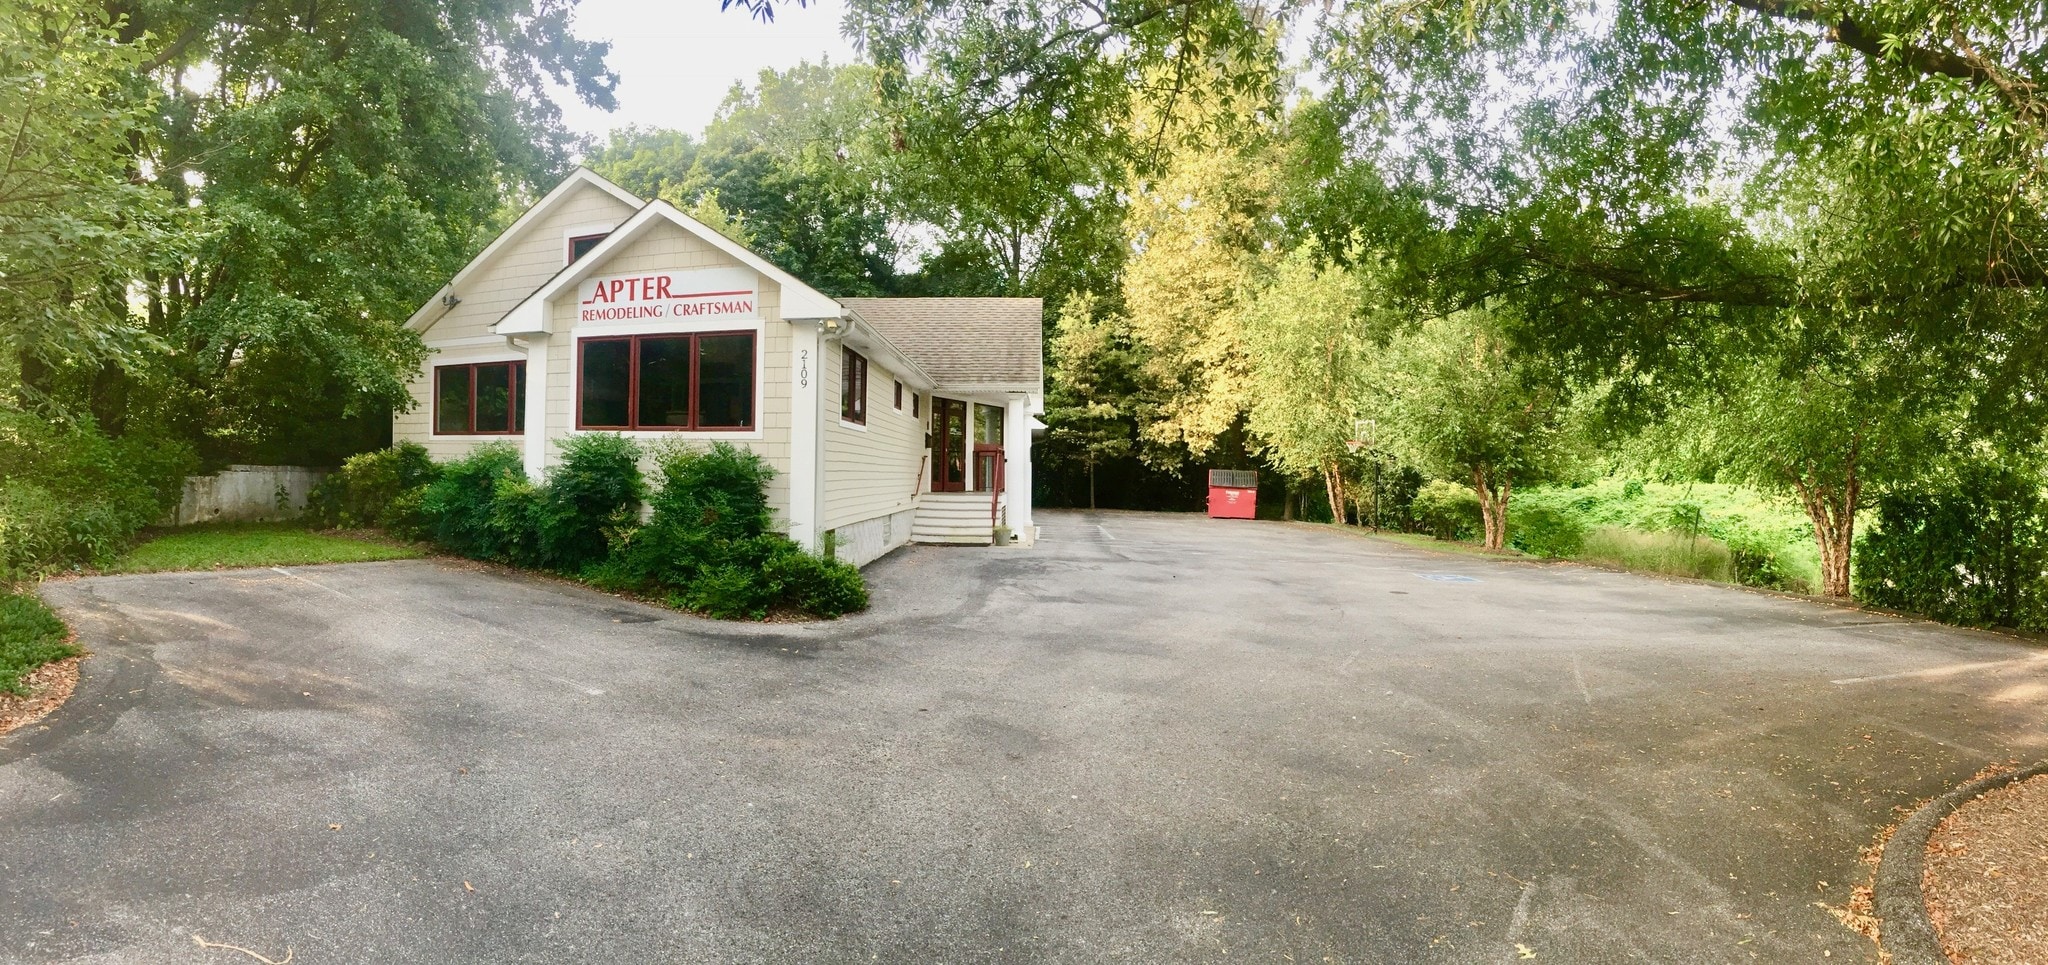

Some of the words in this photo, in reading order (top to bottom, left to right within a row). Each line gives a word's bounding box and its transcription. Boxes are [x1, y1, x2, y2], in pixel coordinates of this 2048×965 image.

[592, 275, 673, 304] APTER
[582, 304, 663, 322] REMODELING
[673, 300, 753, 317] CRAFTSMAN
[800, 349, 808, 389] 2109
